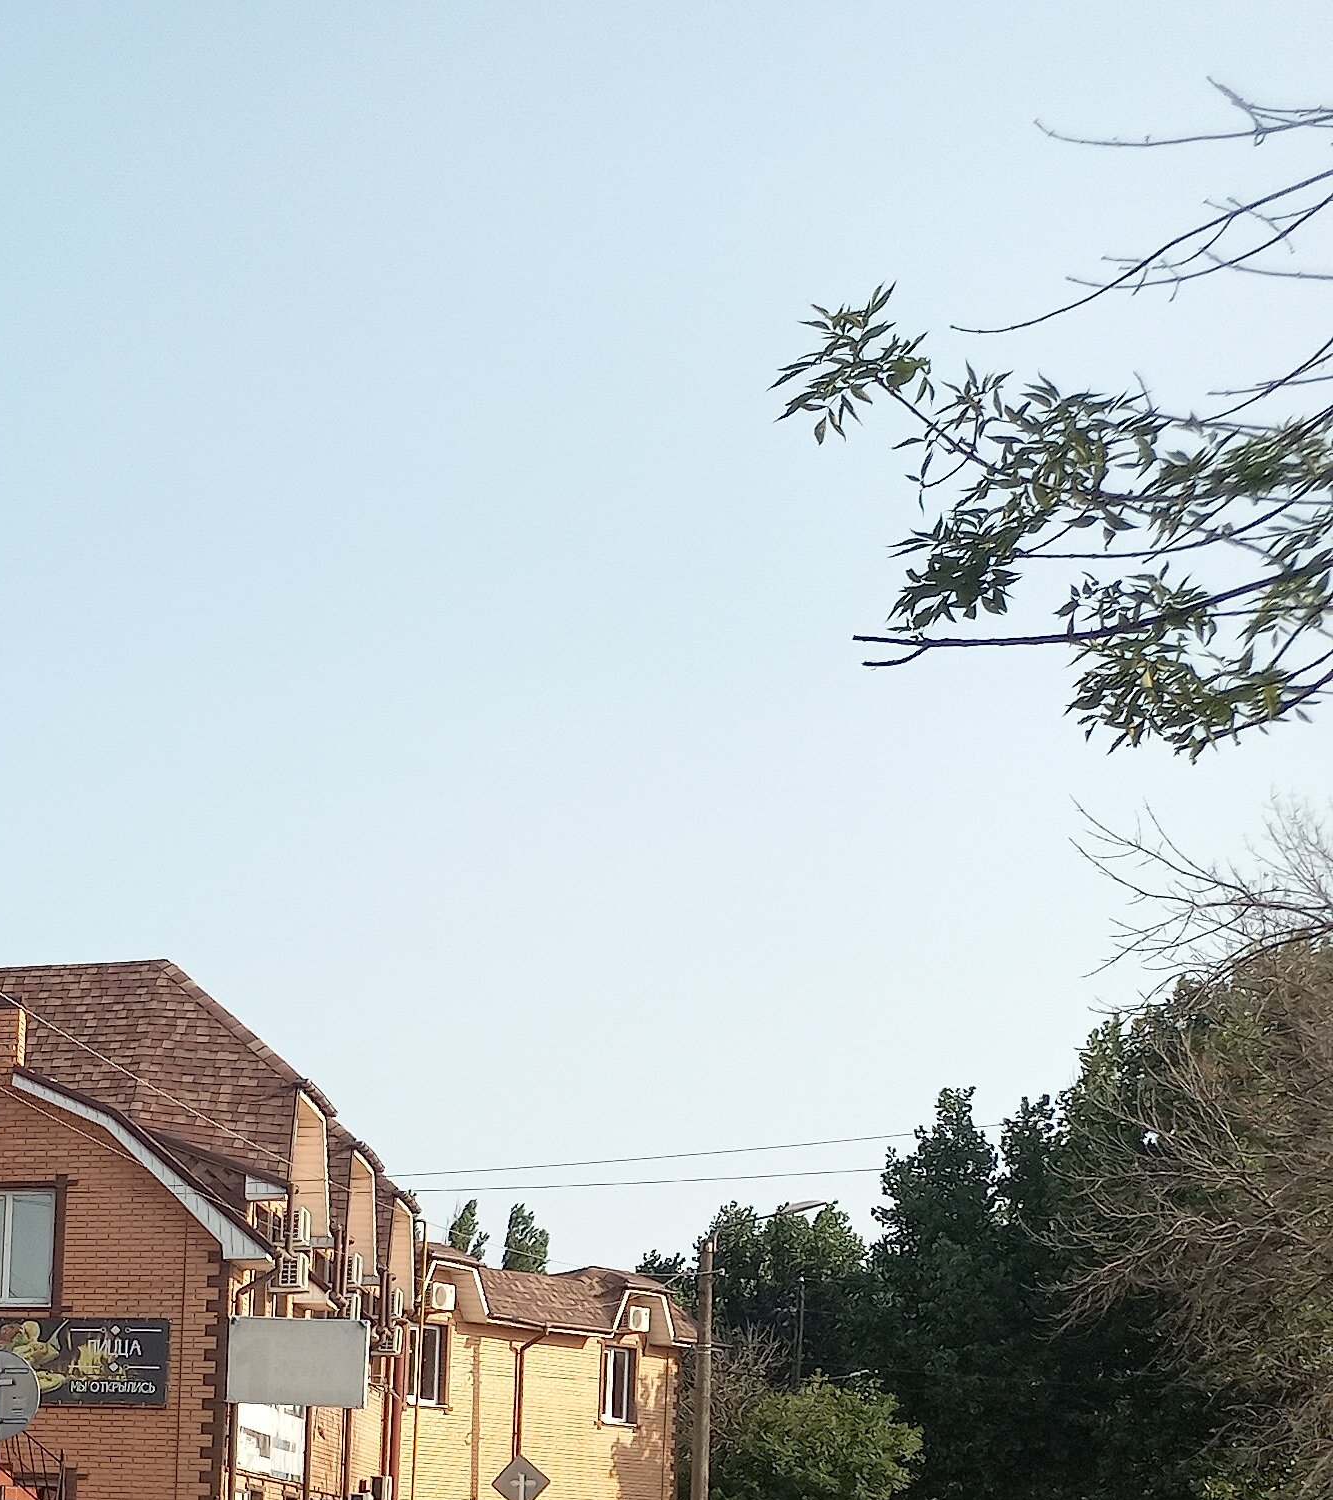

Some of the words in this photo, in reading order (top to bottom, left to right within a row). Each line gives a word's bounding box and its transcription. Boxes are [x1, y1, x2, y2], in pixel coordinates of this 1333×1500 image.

[88, 1338, 142, 1358] ПИЦЦА
[70, 1380, 87, 1393] МЫ
[90, 1380, 156, 1394] ОТКРЫЛИСЬ
